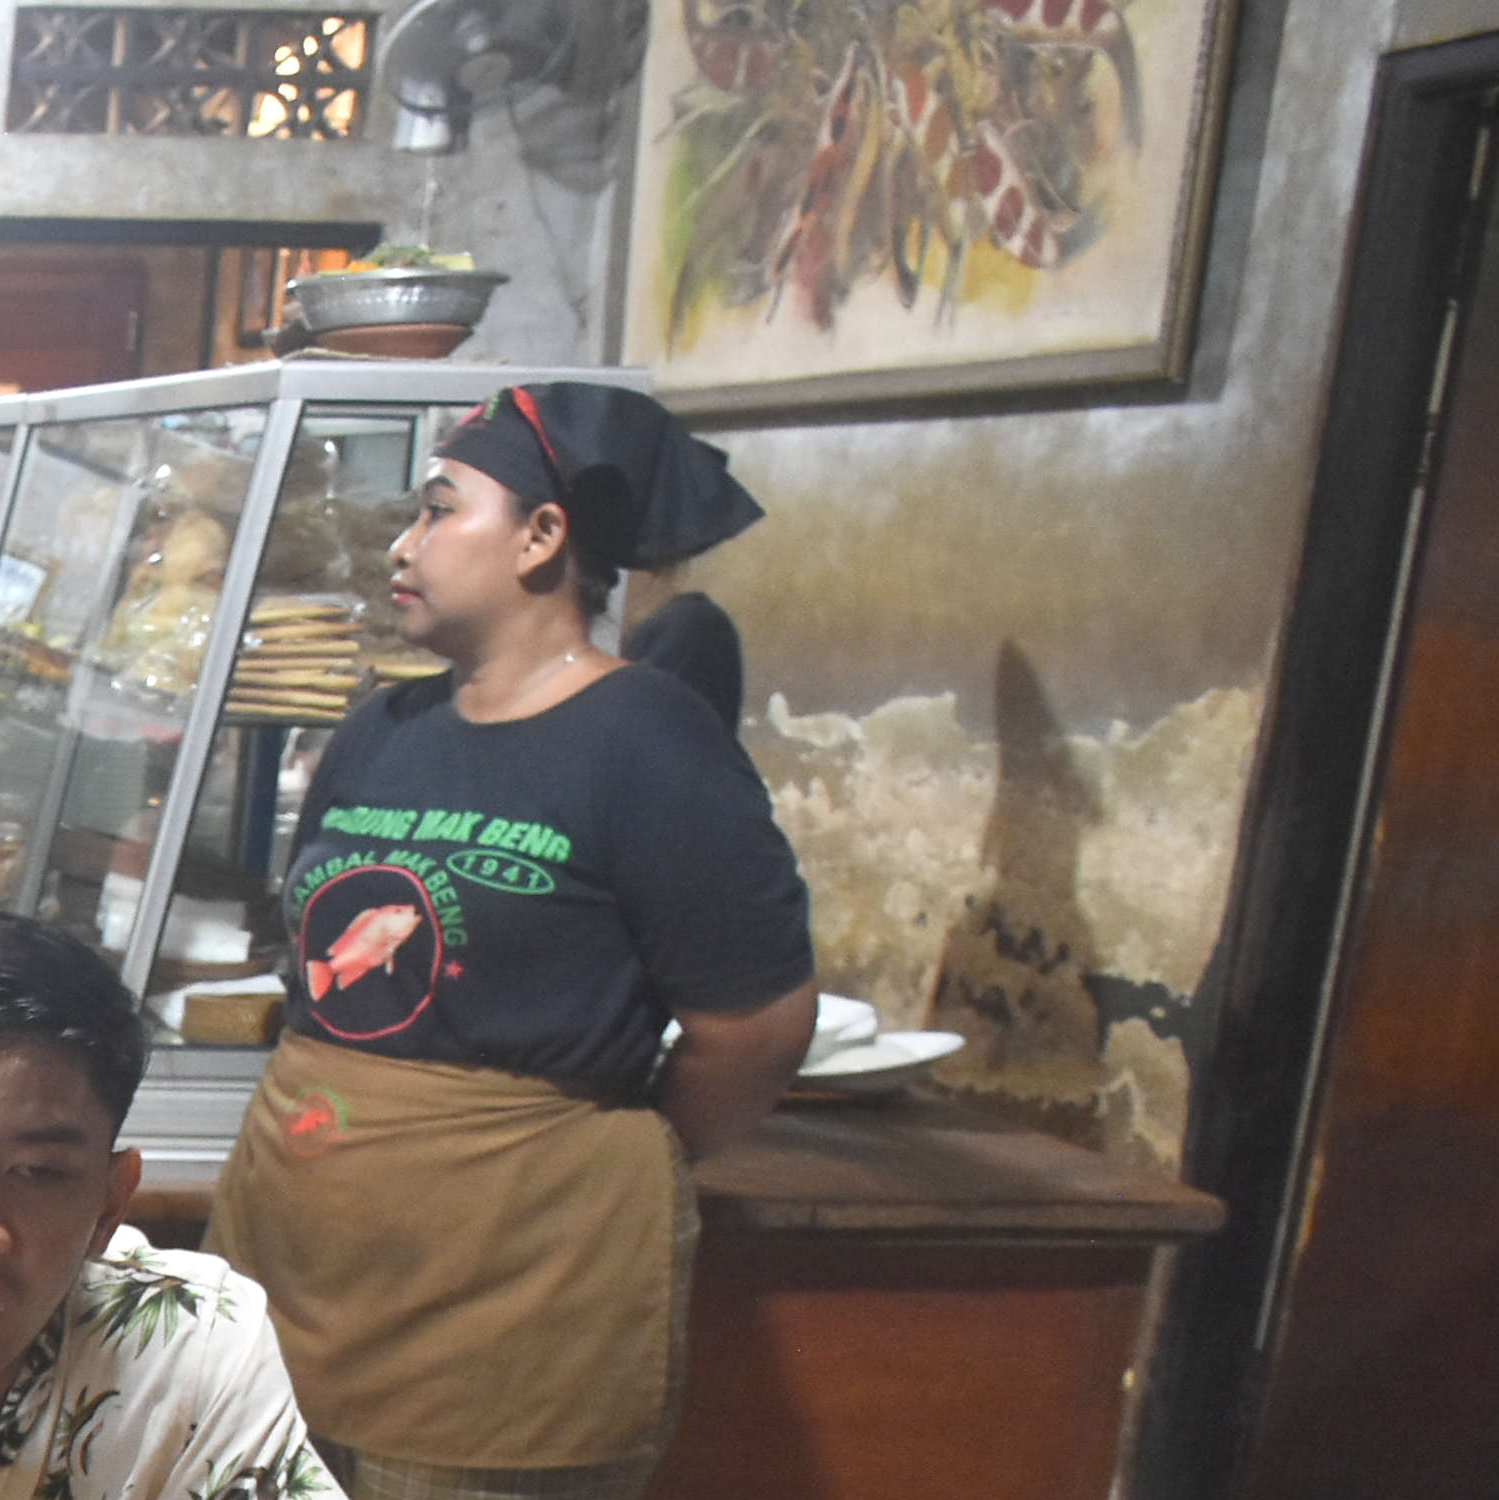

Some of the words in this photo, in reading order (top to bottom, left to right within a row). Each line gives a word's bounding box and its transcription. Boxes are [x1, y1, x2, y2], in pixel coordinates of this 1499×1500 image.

[411, 809, 485, 843] MAK
[462, 855, 542, 889] 1941
[424, 869, 468, 947] BENG
